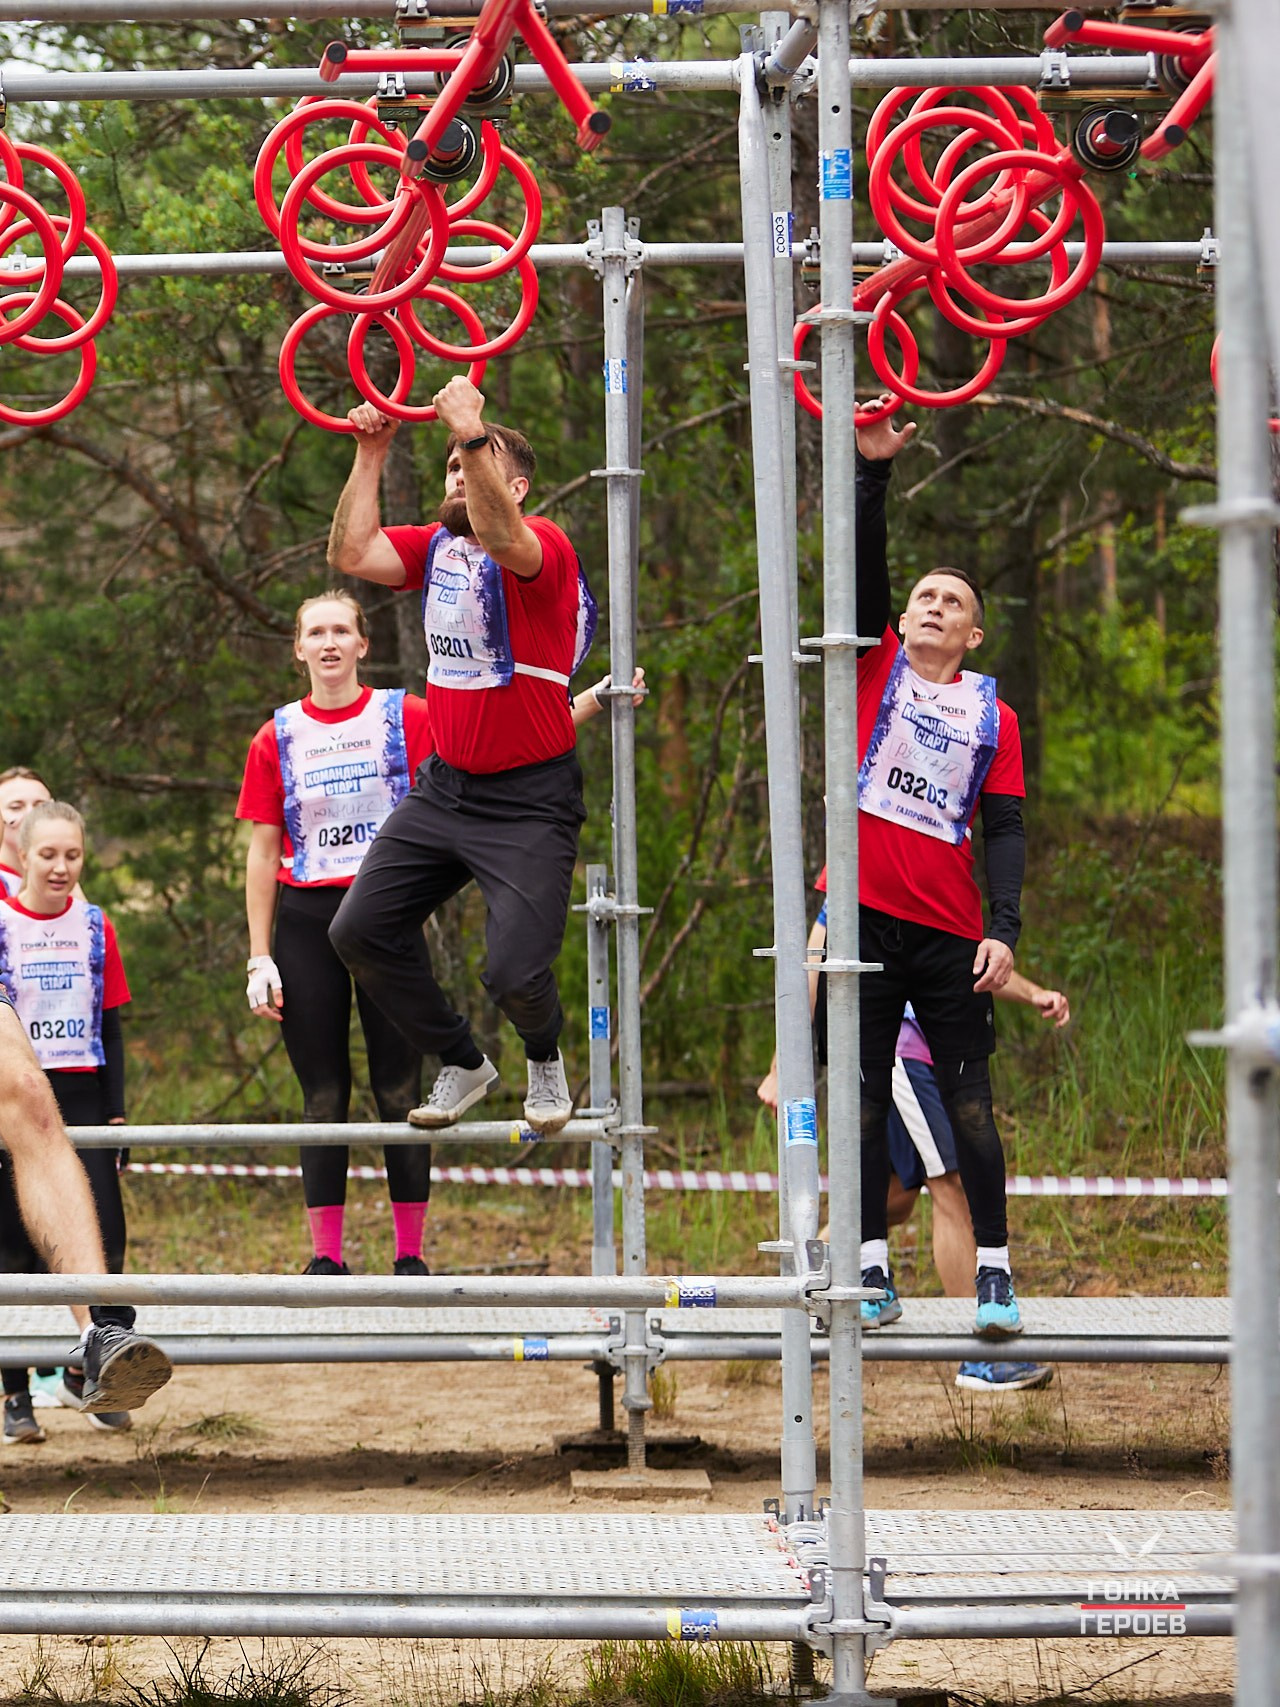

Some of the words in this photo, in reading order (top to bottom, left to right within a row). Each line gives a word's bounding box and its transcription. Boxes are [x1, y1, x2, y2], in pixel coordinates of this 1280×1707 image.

[775, 216, 786, 253] СОЮЗ
[430, 633, 474, 659] 03201
[305, 746, 333, 758] ГОНКА
[336, 739, 371, 750] ГЕРОЕВ
[915, 726, 948, 752] СТАРТ
[305, 761, 377, 787] КОМАНДНЫЙ
[325, 780, 359, 795] СТАРТ
[887, 766, 949, 810] 03203
[318, 822, 378, 847] 03205
[41, 977, 71, 990] СТАРТ
[30, 1019, 85, 1040] 03202
[681, 1624, 712, 1634] СОЮ
